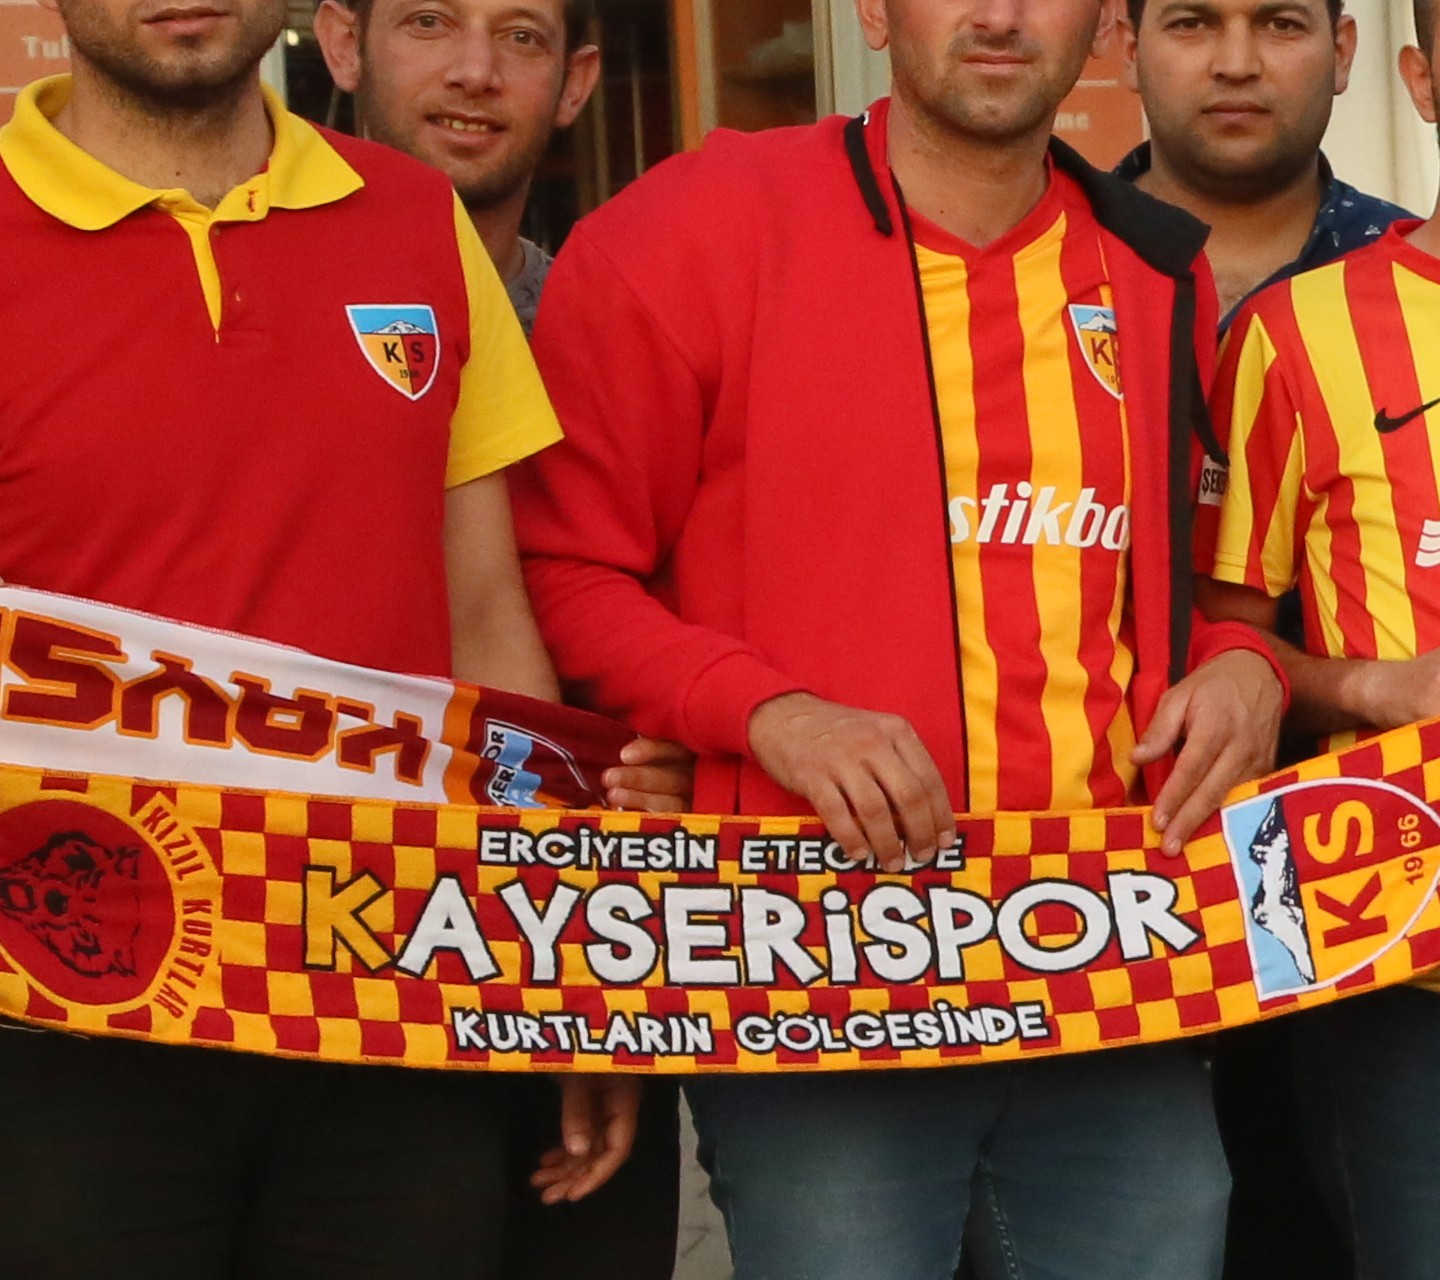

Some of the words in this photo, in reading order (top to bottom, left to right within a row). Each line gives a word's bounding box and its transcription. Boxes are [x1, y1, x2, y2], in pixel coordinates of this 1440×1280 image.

[478, 826, 716, 871] ERCİYESİN
[302, 863, 1200, 987] KAYSERİSPOR
[451, 1009, 714, 1054] KURTLARIN
[736, 999, 1049, 1054] GÖLGESİNDE
